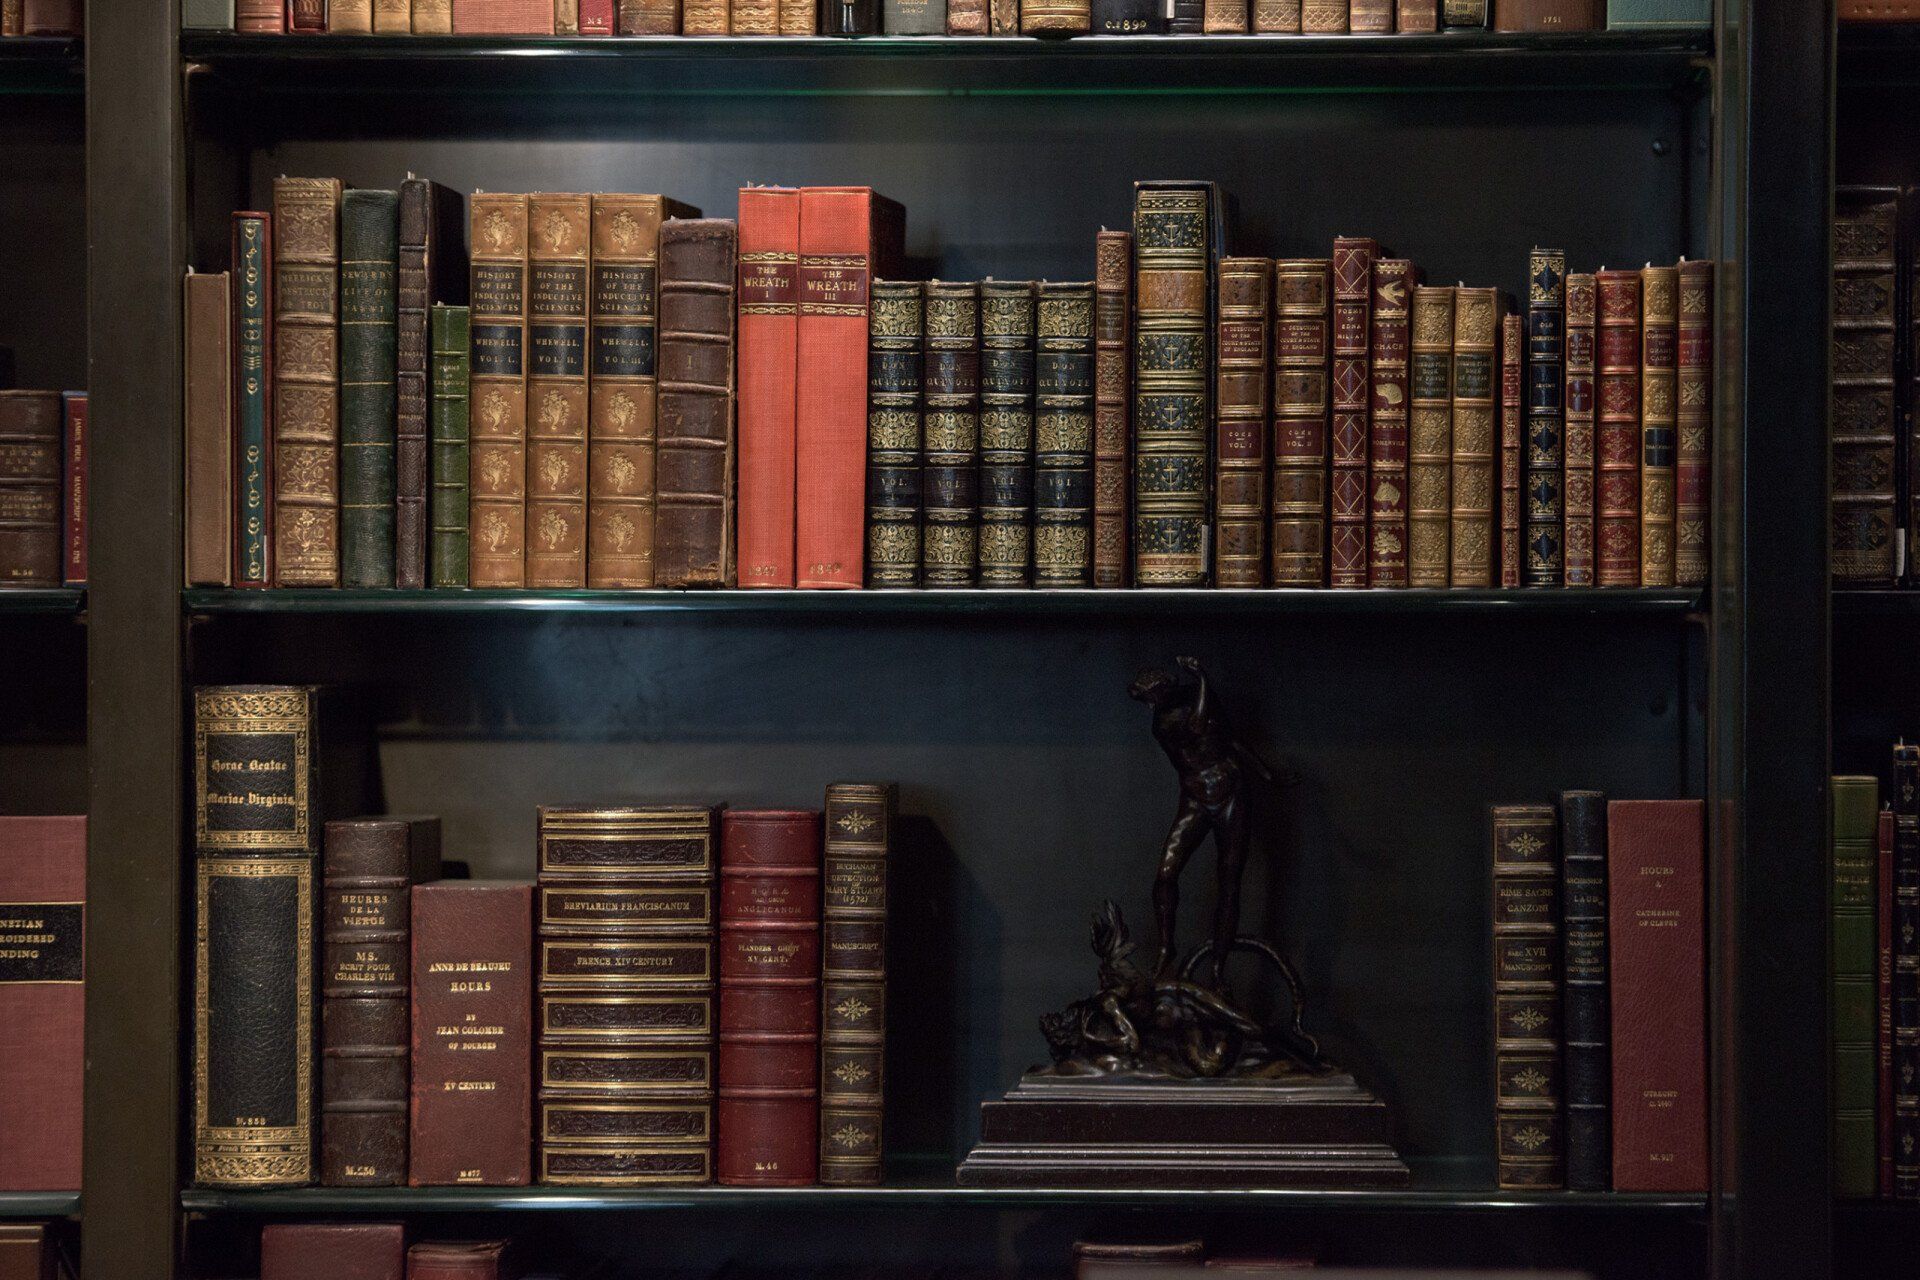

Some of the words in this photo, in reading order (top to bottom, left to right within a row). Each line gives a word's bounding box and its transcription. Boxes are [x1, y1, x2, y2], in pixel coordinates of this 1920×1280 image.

[756, 266, 778, 274] THE
[477, 272, 516, 280] HISTORY
[536, 272, 576, 280] HISTORY
[602, 272, 646, 280] HISTORY
[744, 277, 790, 288] WREATH
[807, 280, 857, 291] WREATH
[474, 292, 521, 301] INDUCTIVE
[533, 293, 583, 301] INDUCTIVE
[598, 293, 651, 301] INDUCTIVE
[765, 290, 770, 298] I
[824, 292, 836, 301] III
[476, 304, 519, 312] SCIENCES
[534, 304, 581, 312] SCIENCES
[1374, 343, 1404, 351] CHACE
[882, 361, 906, 370] DON
[939, 362, 962, 371] DON
[992, 359, 1016, 368] DON
[1052, 362, 1076, 370] DON
[871, 377, 918, 387] QUIXOTE
[926, 378, 975, 387] QUIXOTE
[982, 378, 1030, 386] QUIXOTE
[1039, 379, 1090, 387] QUIXOTE
[1641, 866, 1674, 875] HOURS
[831, 875, 879, 883] DETECTION
[826, 887, 847, 895] MARY
[1500, 888, 1524, 897] RIME
[341, 895, 388, 904] HEURES
[350, 906, 363, 914] DE
[564, 902, 618, 911] BREVIARIUM
[621, 902, 690, 911] FRANCISCANUM
[737, 906, 801, 914] ANGLICANUM
[1507, 904, 1549, 913] CANZONI
[343, 917, 386, 925] VIERGE
[738, 944, 772, 952] FLANDERS
[831, 942, 879, 950] MANUSCRIPT
[0, 949, 40, 959] NDING
[1524, 947, 1547, 957] XVII
[577, 957, 612, 966] FRENCH
[615, 957, 632, 966] XIV
[632, 956, 674, 966] CENTURY
[1879, 946, 1891, 984] BOOK
[429, 963, 454, 972] ANNE
[456, 963, 469, 971] DE
[470, 962, 512, 972] BEAUJEU
[1504, 963, 1553, 971] MANUSCRIPT
[334, 972, 376, 981] CHARLES
[451, 981, 491, 992] HOURS
[1879, 992, 1891, 1034] IDEAL
[436, 1026, 460, 1035] JEAN
[461, 1026, 504, 1035] COLOMBE
[1879, 1042, 1891, 1067] THE
[444, 1082, 458, 1091] XV
[458, 1082, 496, 1091] CENTURY
